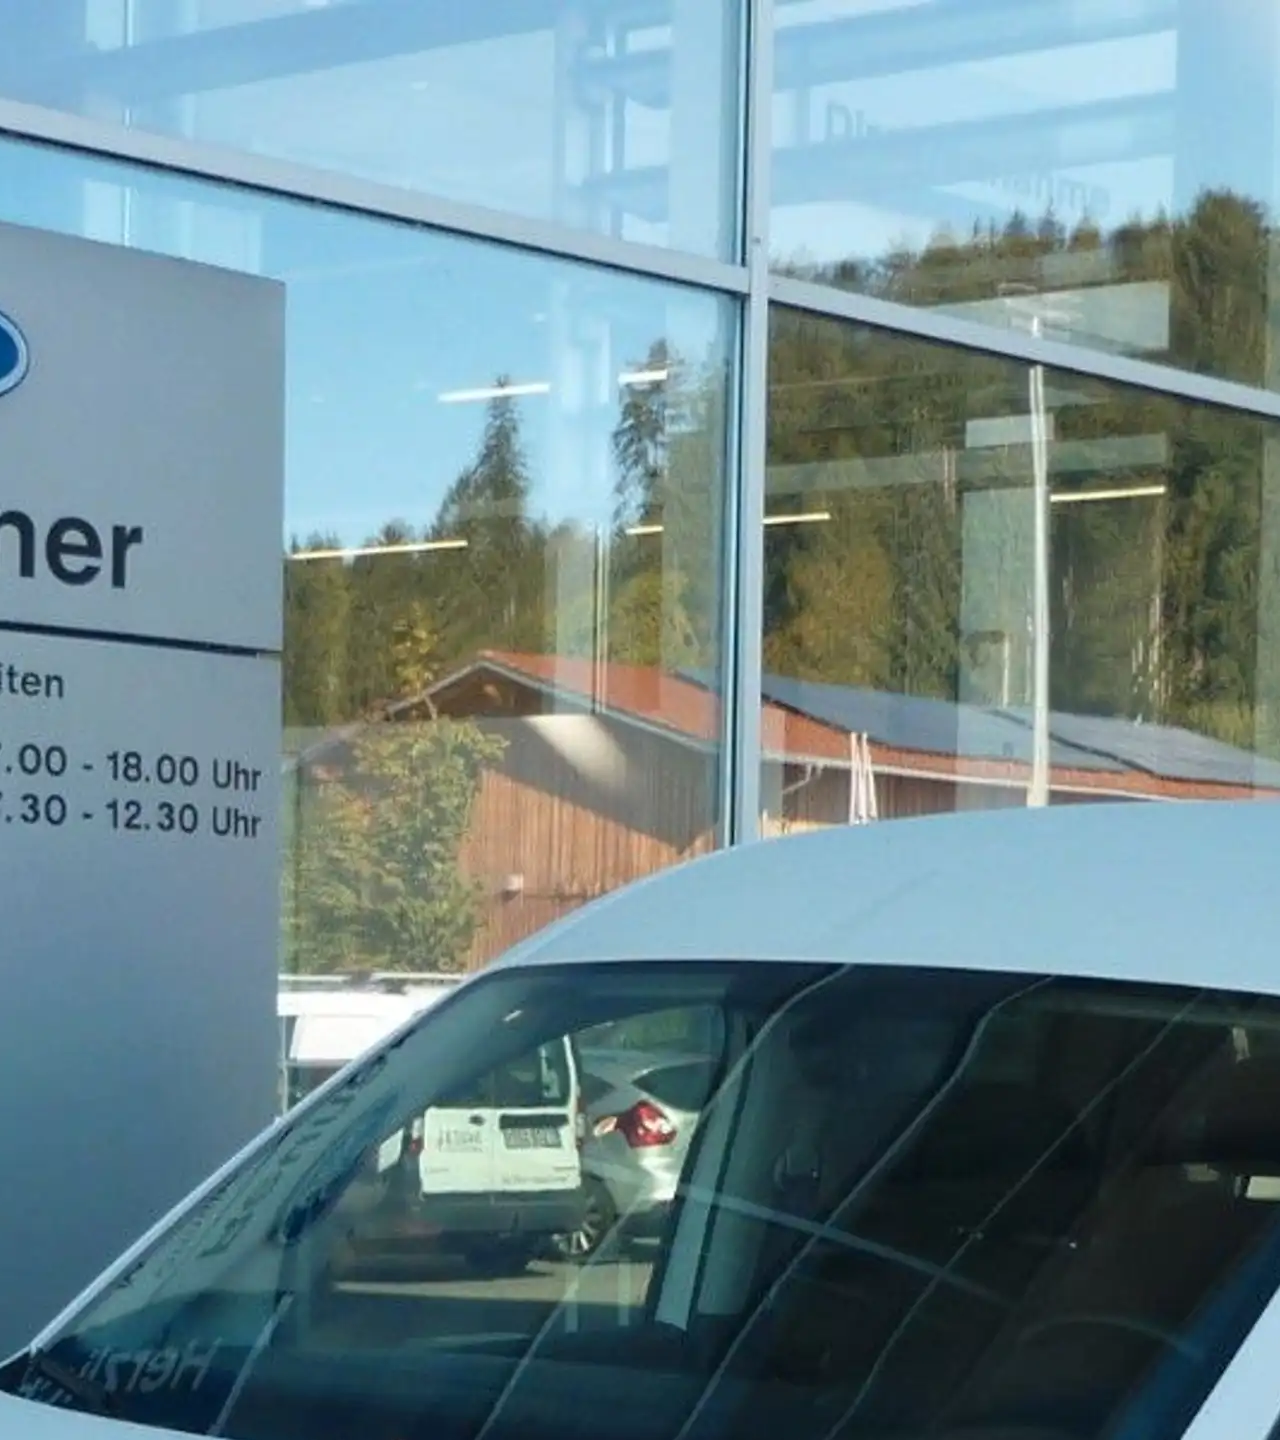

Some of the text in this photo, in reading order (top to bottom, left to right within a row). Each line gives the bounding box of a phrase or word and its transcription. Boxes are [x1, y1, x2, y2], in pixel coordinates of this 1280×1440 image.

[105, 750, 199, 787] 18.00
[212, 758, 262, 792] Uhr
[105, 798, 199, 834] 12.30
[212, 805, 262, 838] Uhr
